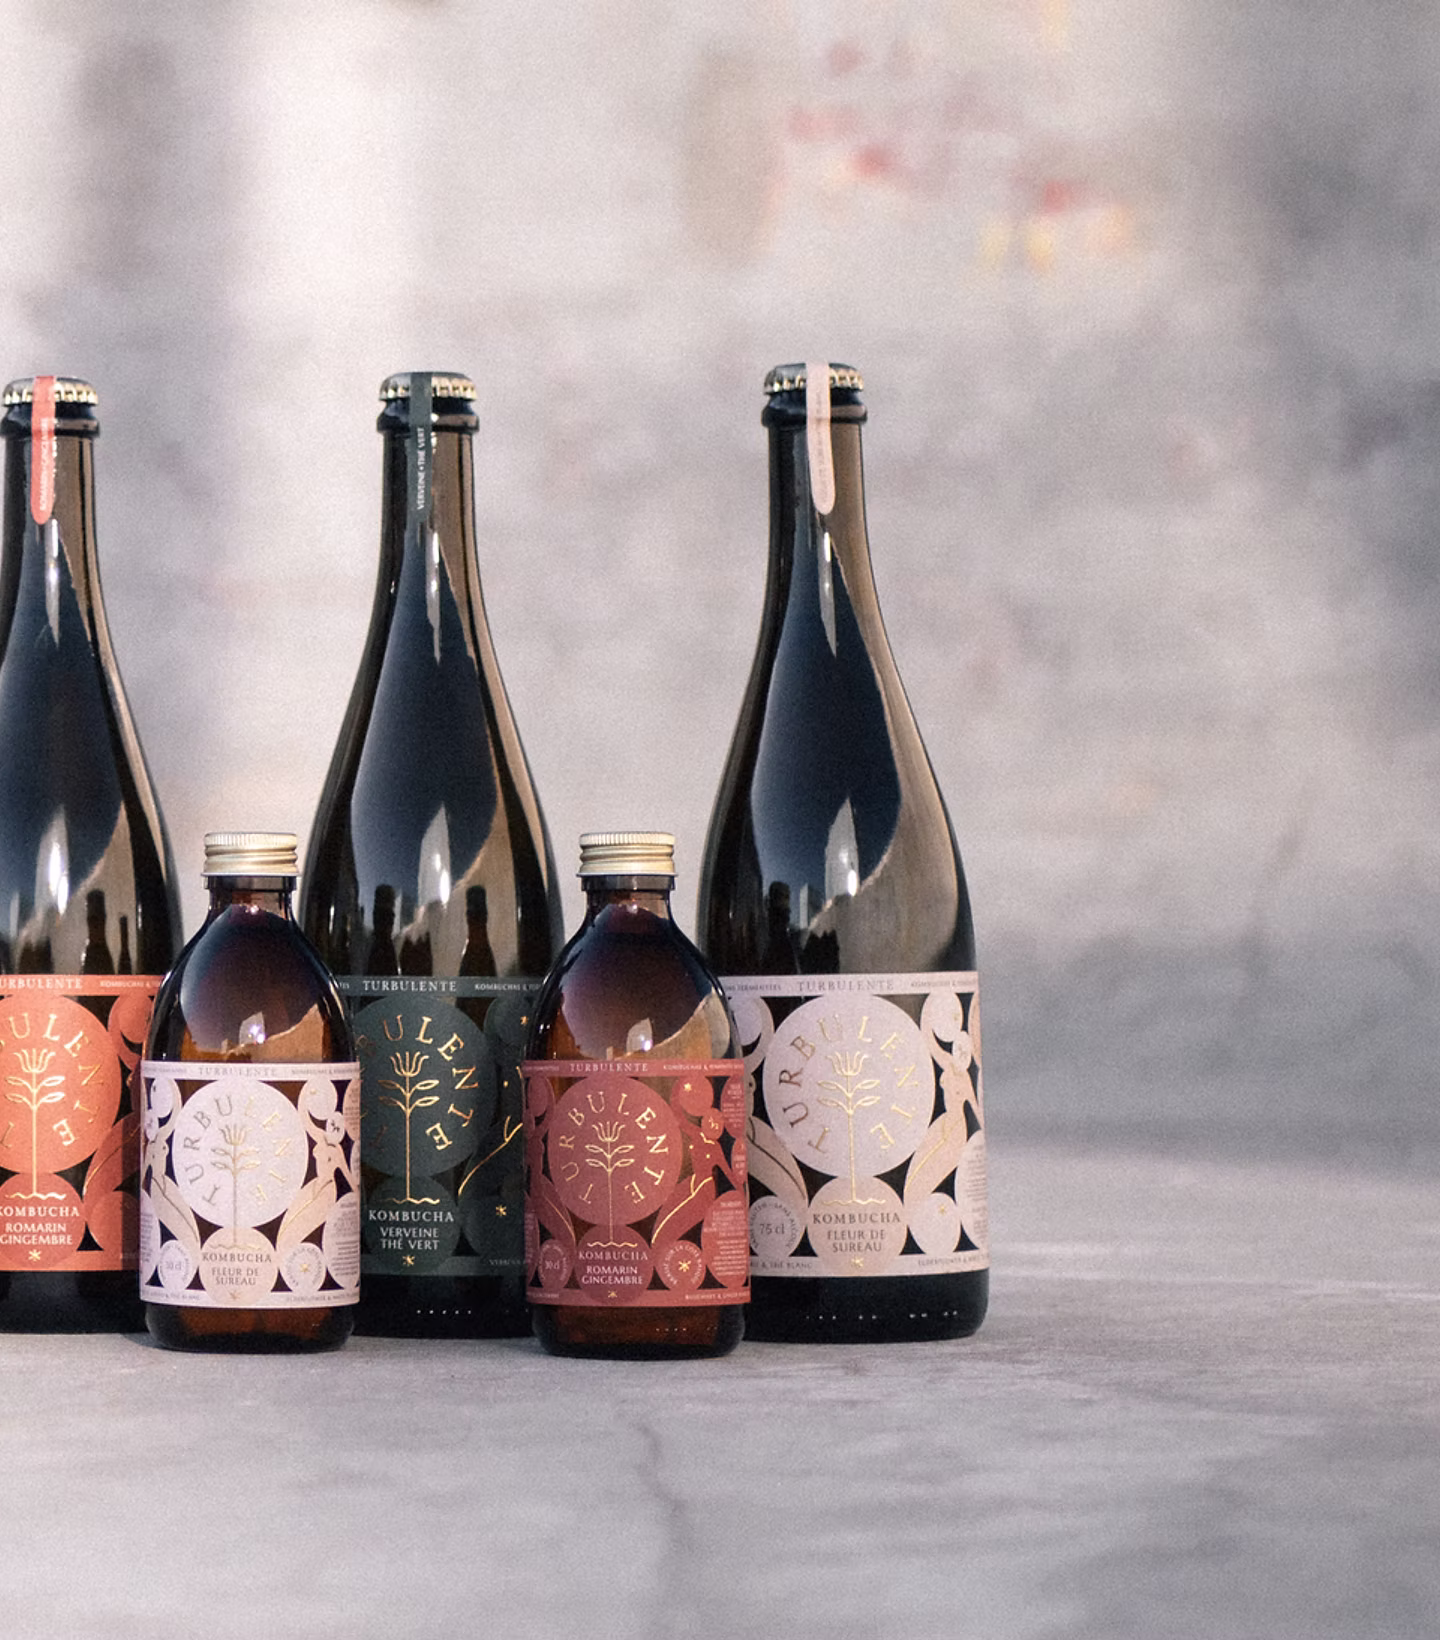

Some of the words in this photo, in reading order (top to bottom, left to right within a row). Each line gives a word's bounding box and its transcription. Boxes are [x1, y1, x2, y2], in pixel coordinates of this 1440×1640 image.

[363, 981, 457, 992] TURBULENTE
[797, 980, 894, 992] TURBULENTE
[570, 1063, 649, 1072] TURBULENTE
[779, 1013, 919, 1153] TURBULENTE
[559, 1091, 668, 1204] TURBULENTE
[368, 1210, 454, 1222] KOMBUCHA
[812, 1212, 901, 1224] KOMBUCHA
[5, 1222, 67, 1233] ROMARIN
[380, 1228, 439, 1238] VERVEINE
[760, 1223, 772, 1235] 75
[0, 1234, 73, 1245] GINGEMBRE
[827, 1230, 865, 1241] FLEUR
[870, 1229, 886, 1240] DE
[380, 1237, 403, 1249] THÉ
[409, 1240, 440, 1250] VERT
[832, 1242, 882, 1253] SUREAU
[202, 1253, 272, 1263] KOMBUCHA
[579, 1251, 648, 1261] KOMBUCHA
[212, 1267, 242, 1277] FLEUR
[247, 1267, 259, 1277] DE
[586, 1266, 638, 1275] ROMARIN
[215, 1277, 257, 1286] SUREAU
[581, 1275, 643, 1285] GINGEMBRE
